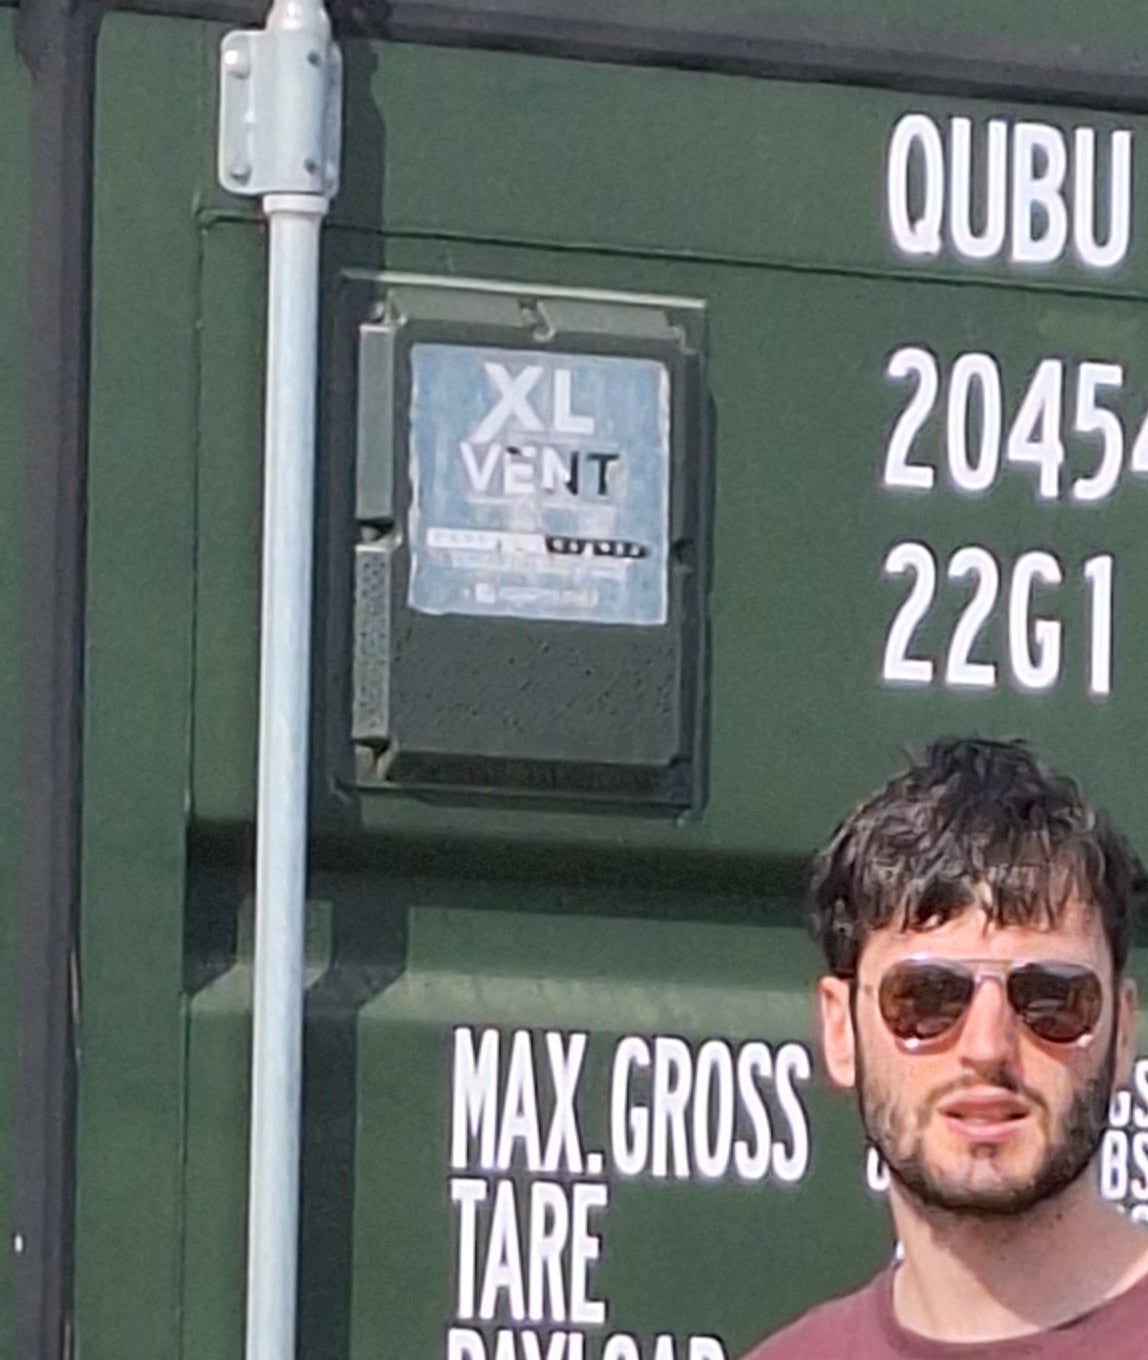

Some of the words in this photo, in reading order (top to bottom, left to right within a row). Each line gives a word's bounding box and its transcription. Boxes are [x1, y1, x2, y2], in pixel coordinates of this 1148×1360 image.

[887, 113, 1133, 268] QUBU
[460, 441, 620, 496] VENT
[468, 360, 595, 444] XL
[882, 541, 1113, 695] 22G1
[450, 1177, 608, 1325] TARE
